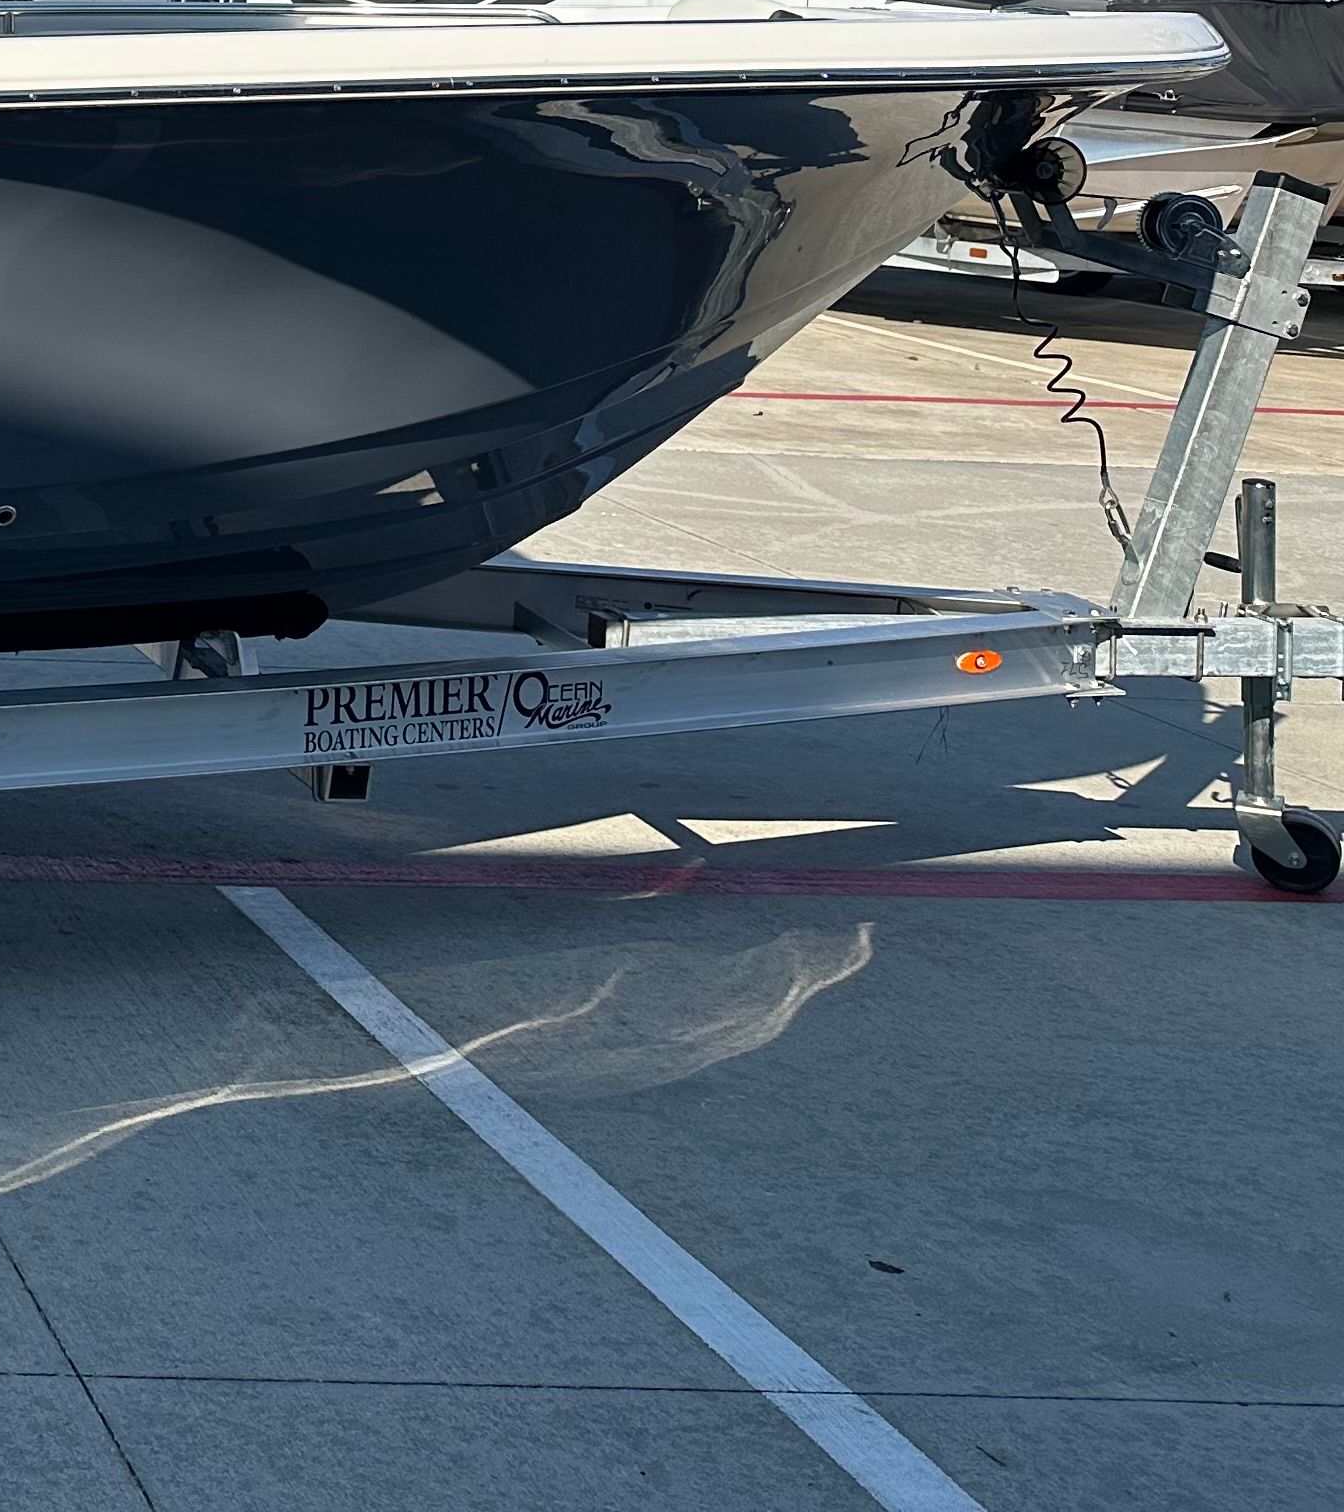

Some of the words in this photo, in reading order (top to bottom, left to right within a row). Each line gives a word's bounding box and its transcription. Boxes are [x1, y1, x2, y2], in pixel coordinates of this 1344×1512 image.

[304, 675, 499, 726] PREMIER
[513, 672, 604, 718] OCEAN
[524, 696, 612, 730] Marine
[303, 726, 399, 754] BOATING
[402, 716, 496, 745] CENTERS
[567, 721, 609, 731] GROUP
